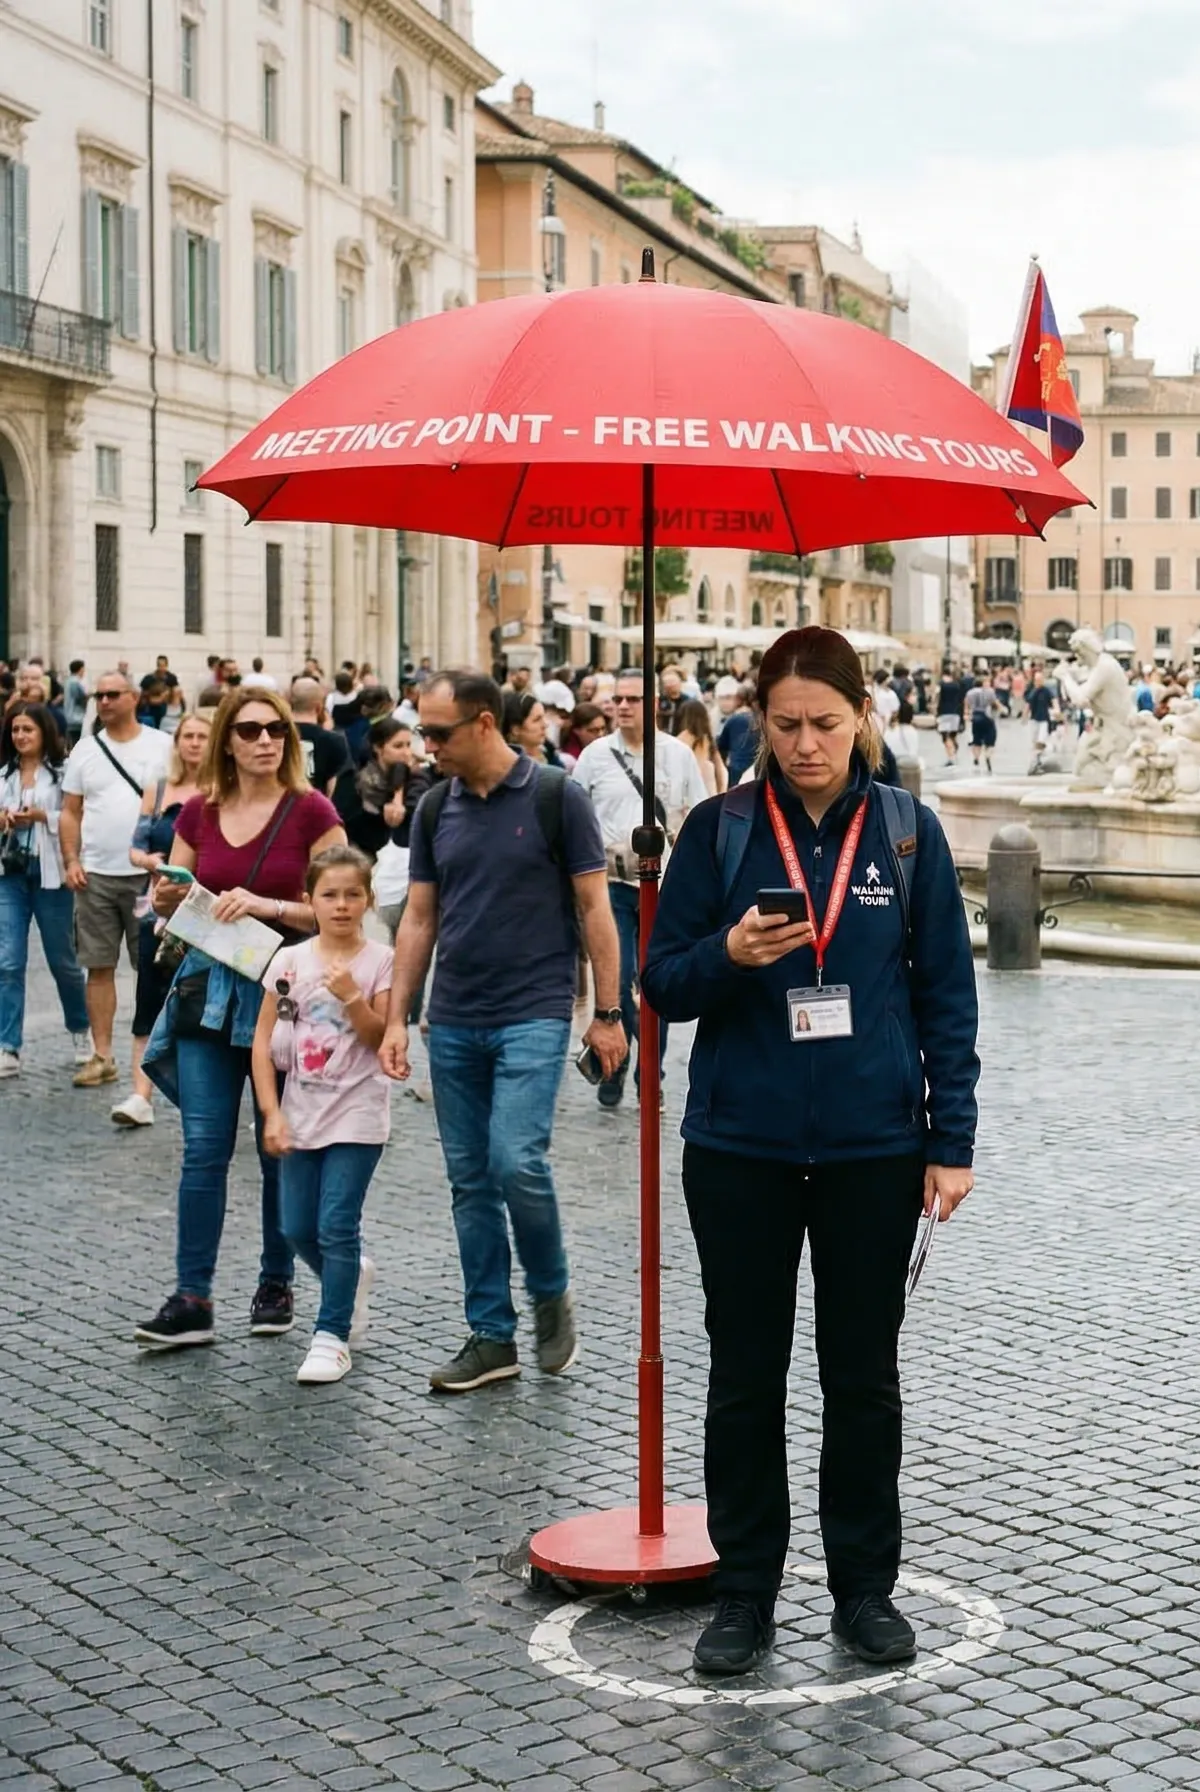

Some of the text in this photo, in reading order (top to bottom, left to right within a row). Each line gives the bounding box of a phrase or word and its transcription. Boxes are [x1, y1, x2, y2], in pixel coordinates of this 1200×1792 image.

[251, 412, 1039, 478] MEETING POINT - FREE WALKING TOURS
[858, 896, 890, 906] TOURS
